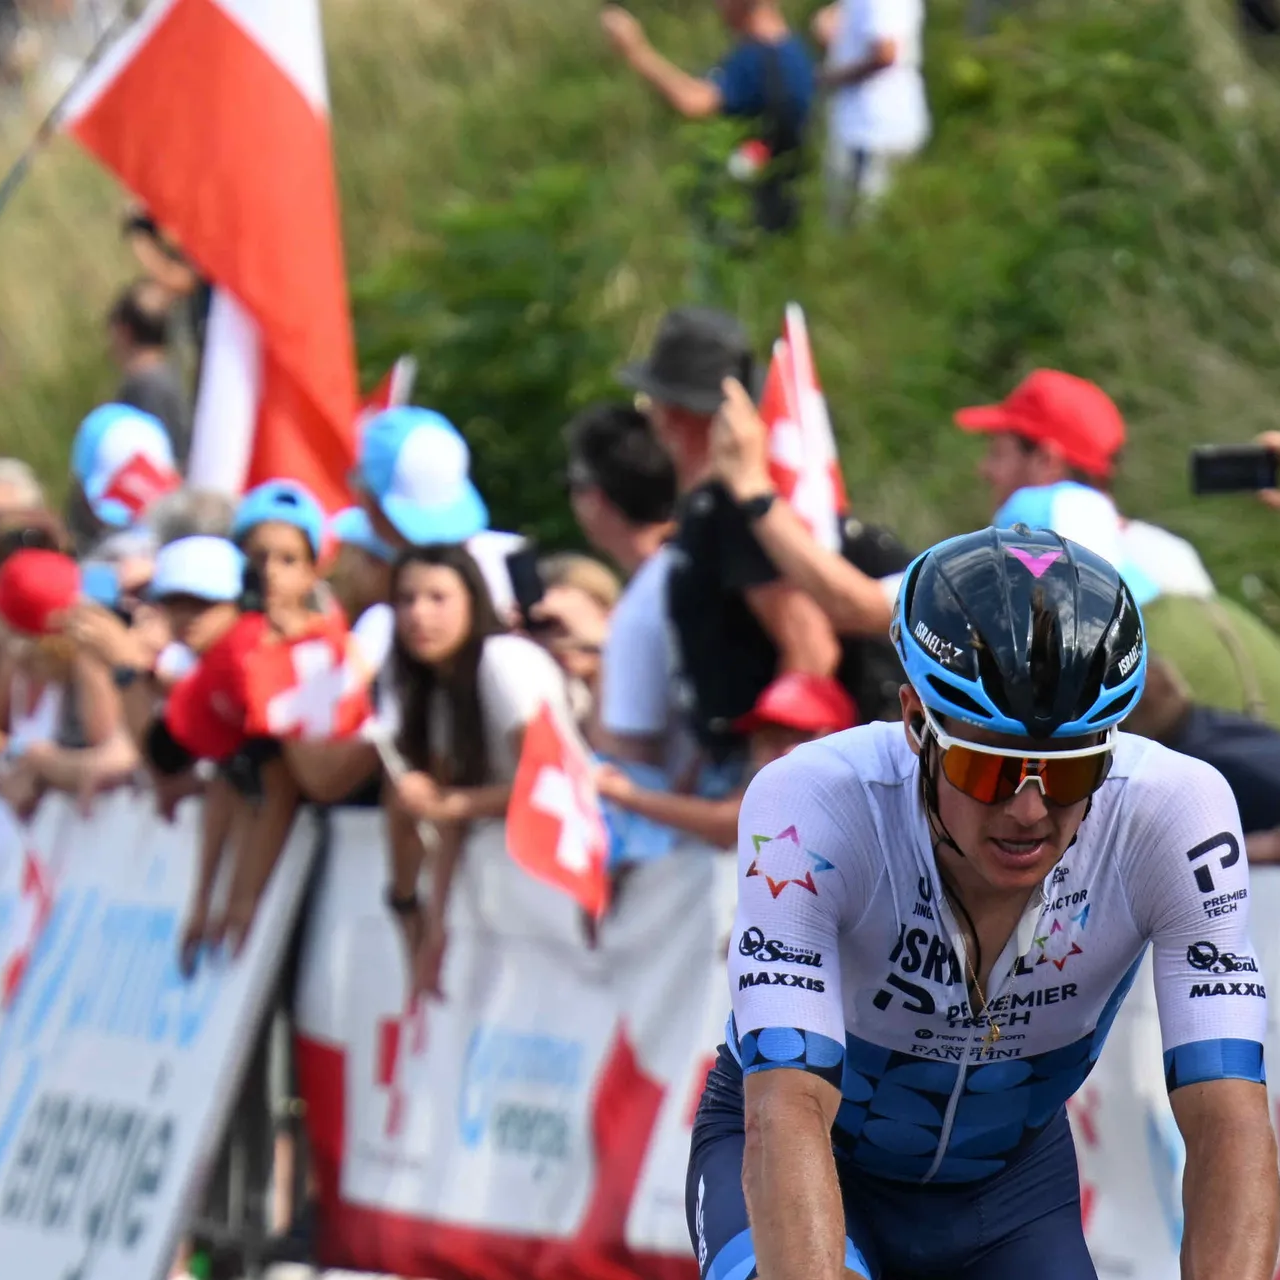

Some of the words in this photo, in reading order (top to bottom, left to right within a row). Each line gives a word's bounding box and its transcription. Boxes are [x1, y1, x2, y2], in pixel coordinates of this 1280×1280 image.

[914, 620, 942, 655] ISRAEL
[1117, 645, 1139, 677] ISRAEL
[1042, 889, 1088, 917] FACTOR
[1203, 888, 1248, 910] PREMIER
[1204, 902, 1238, 919] TECH
[753, 940, 823, 968] Seal
[782, 945, 814, 955] ORANGE
[1208, 952, 1258, 974] Seal
[739, 971, 825, 993] MAXXIS
[1189, 982, 1266, 999] MAXXIS
